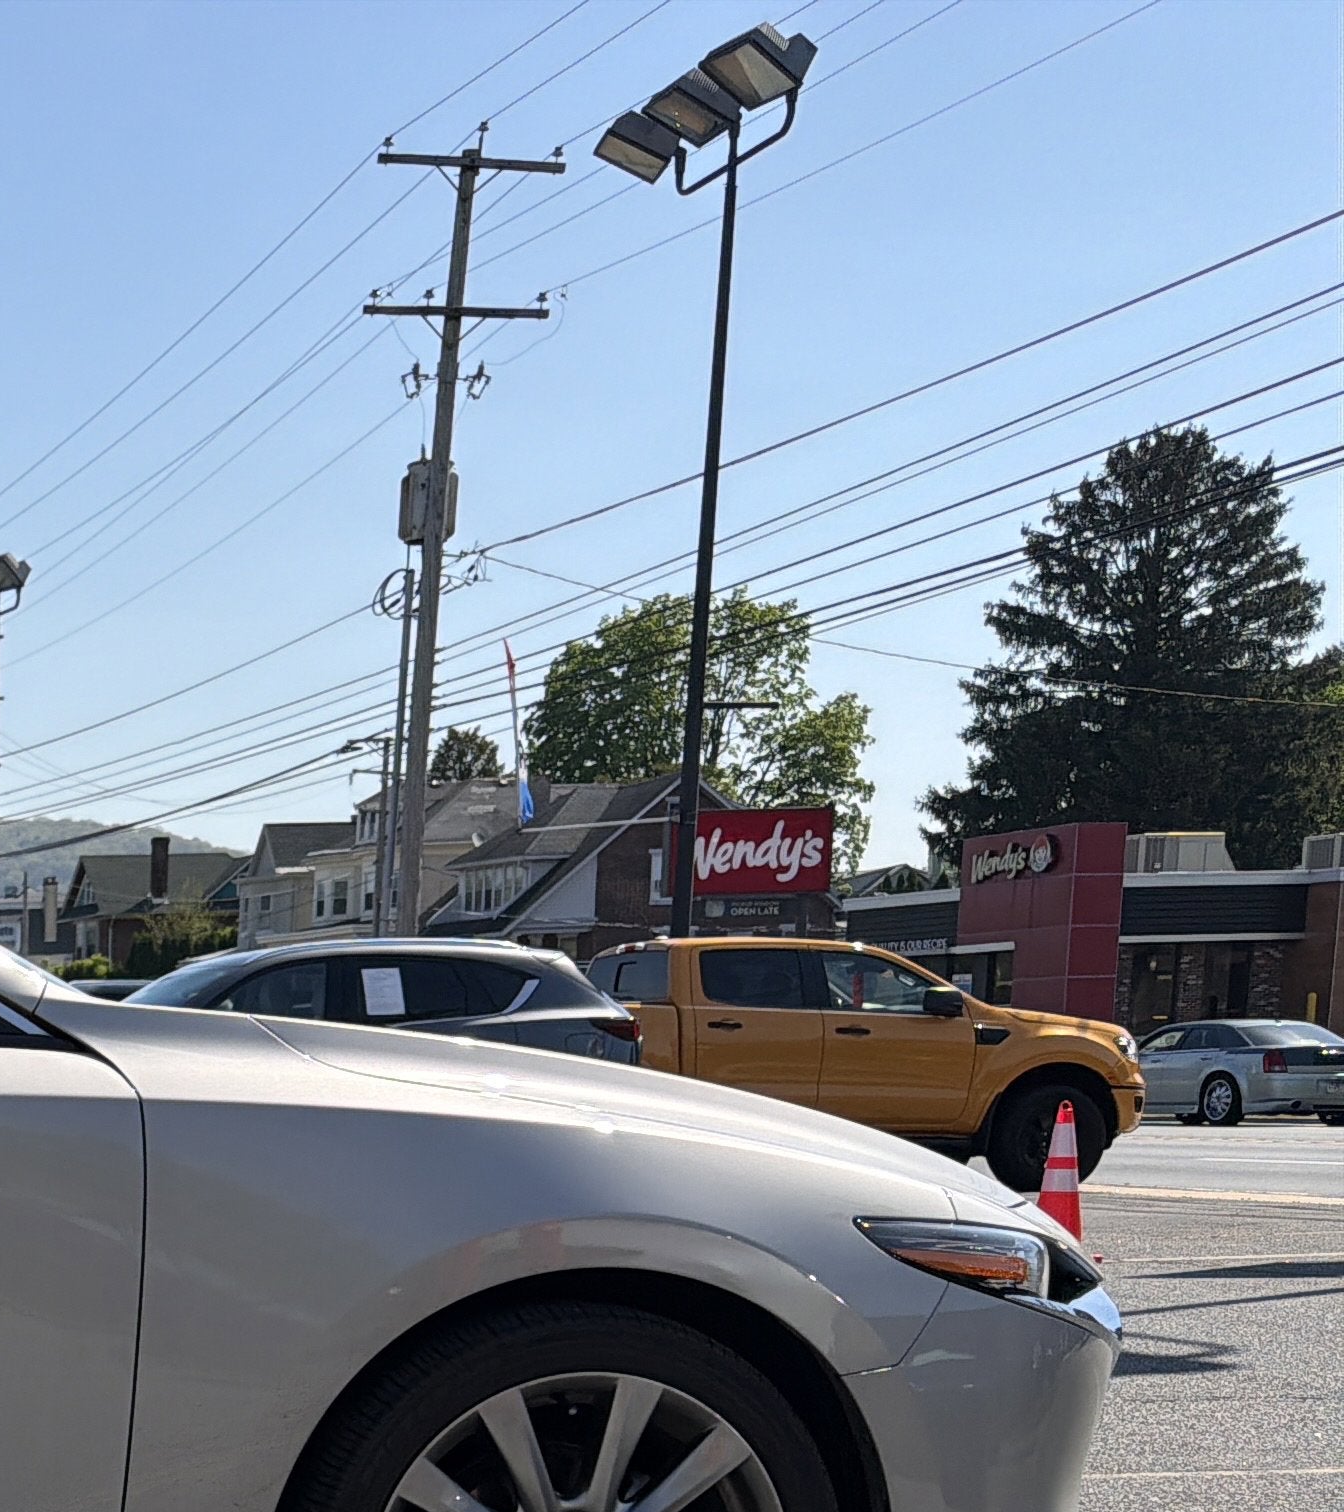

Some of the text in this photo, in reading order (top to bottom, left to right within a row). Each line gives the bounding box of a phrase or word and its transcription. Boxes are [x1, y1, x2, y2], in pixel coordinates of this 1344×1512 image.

[970, 841, 1027, 885] Wendy's
[730, 906, 780, 916] OPEN LATE
